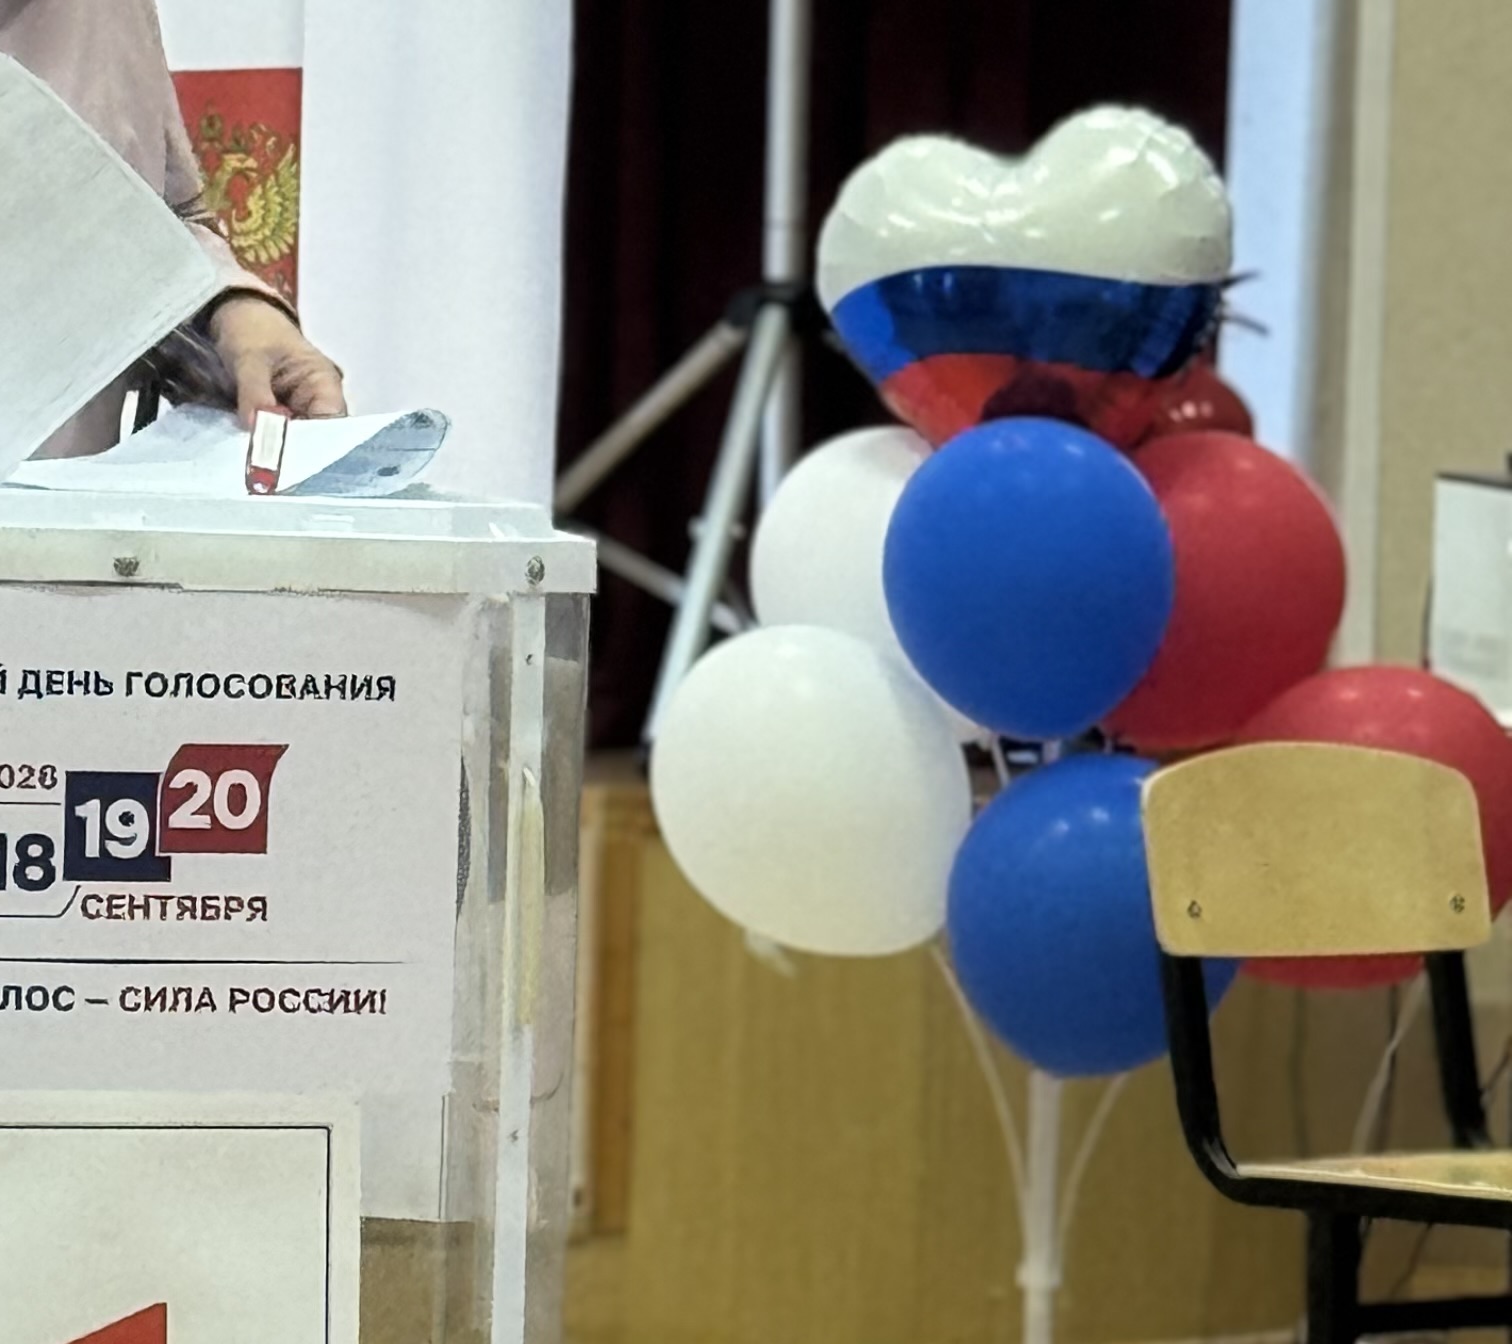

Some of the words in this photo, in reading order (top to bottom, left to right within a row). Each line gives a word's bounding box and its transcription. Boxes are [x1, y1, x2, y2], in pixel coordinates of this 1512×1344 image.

[17, 669, 114, 699] ДЕНЬ
[124, 670, 396, 701] ГОЛОСОВАНИЯ
[74, 798, 150, 859] 19
[168, 768, 261, 830] 20
[81, 894, 268, 922] СЕНТЯБРЯ
[119, 986, 217, 1014] СИЛА
